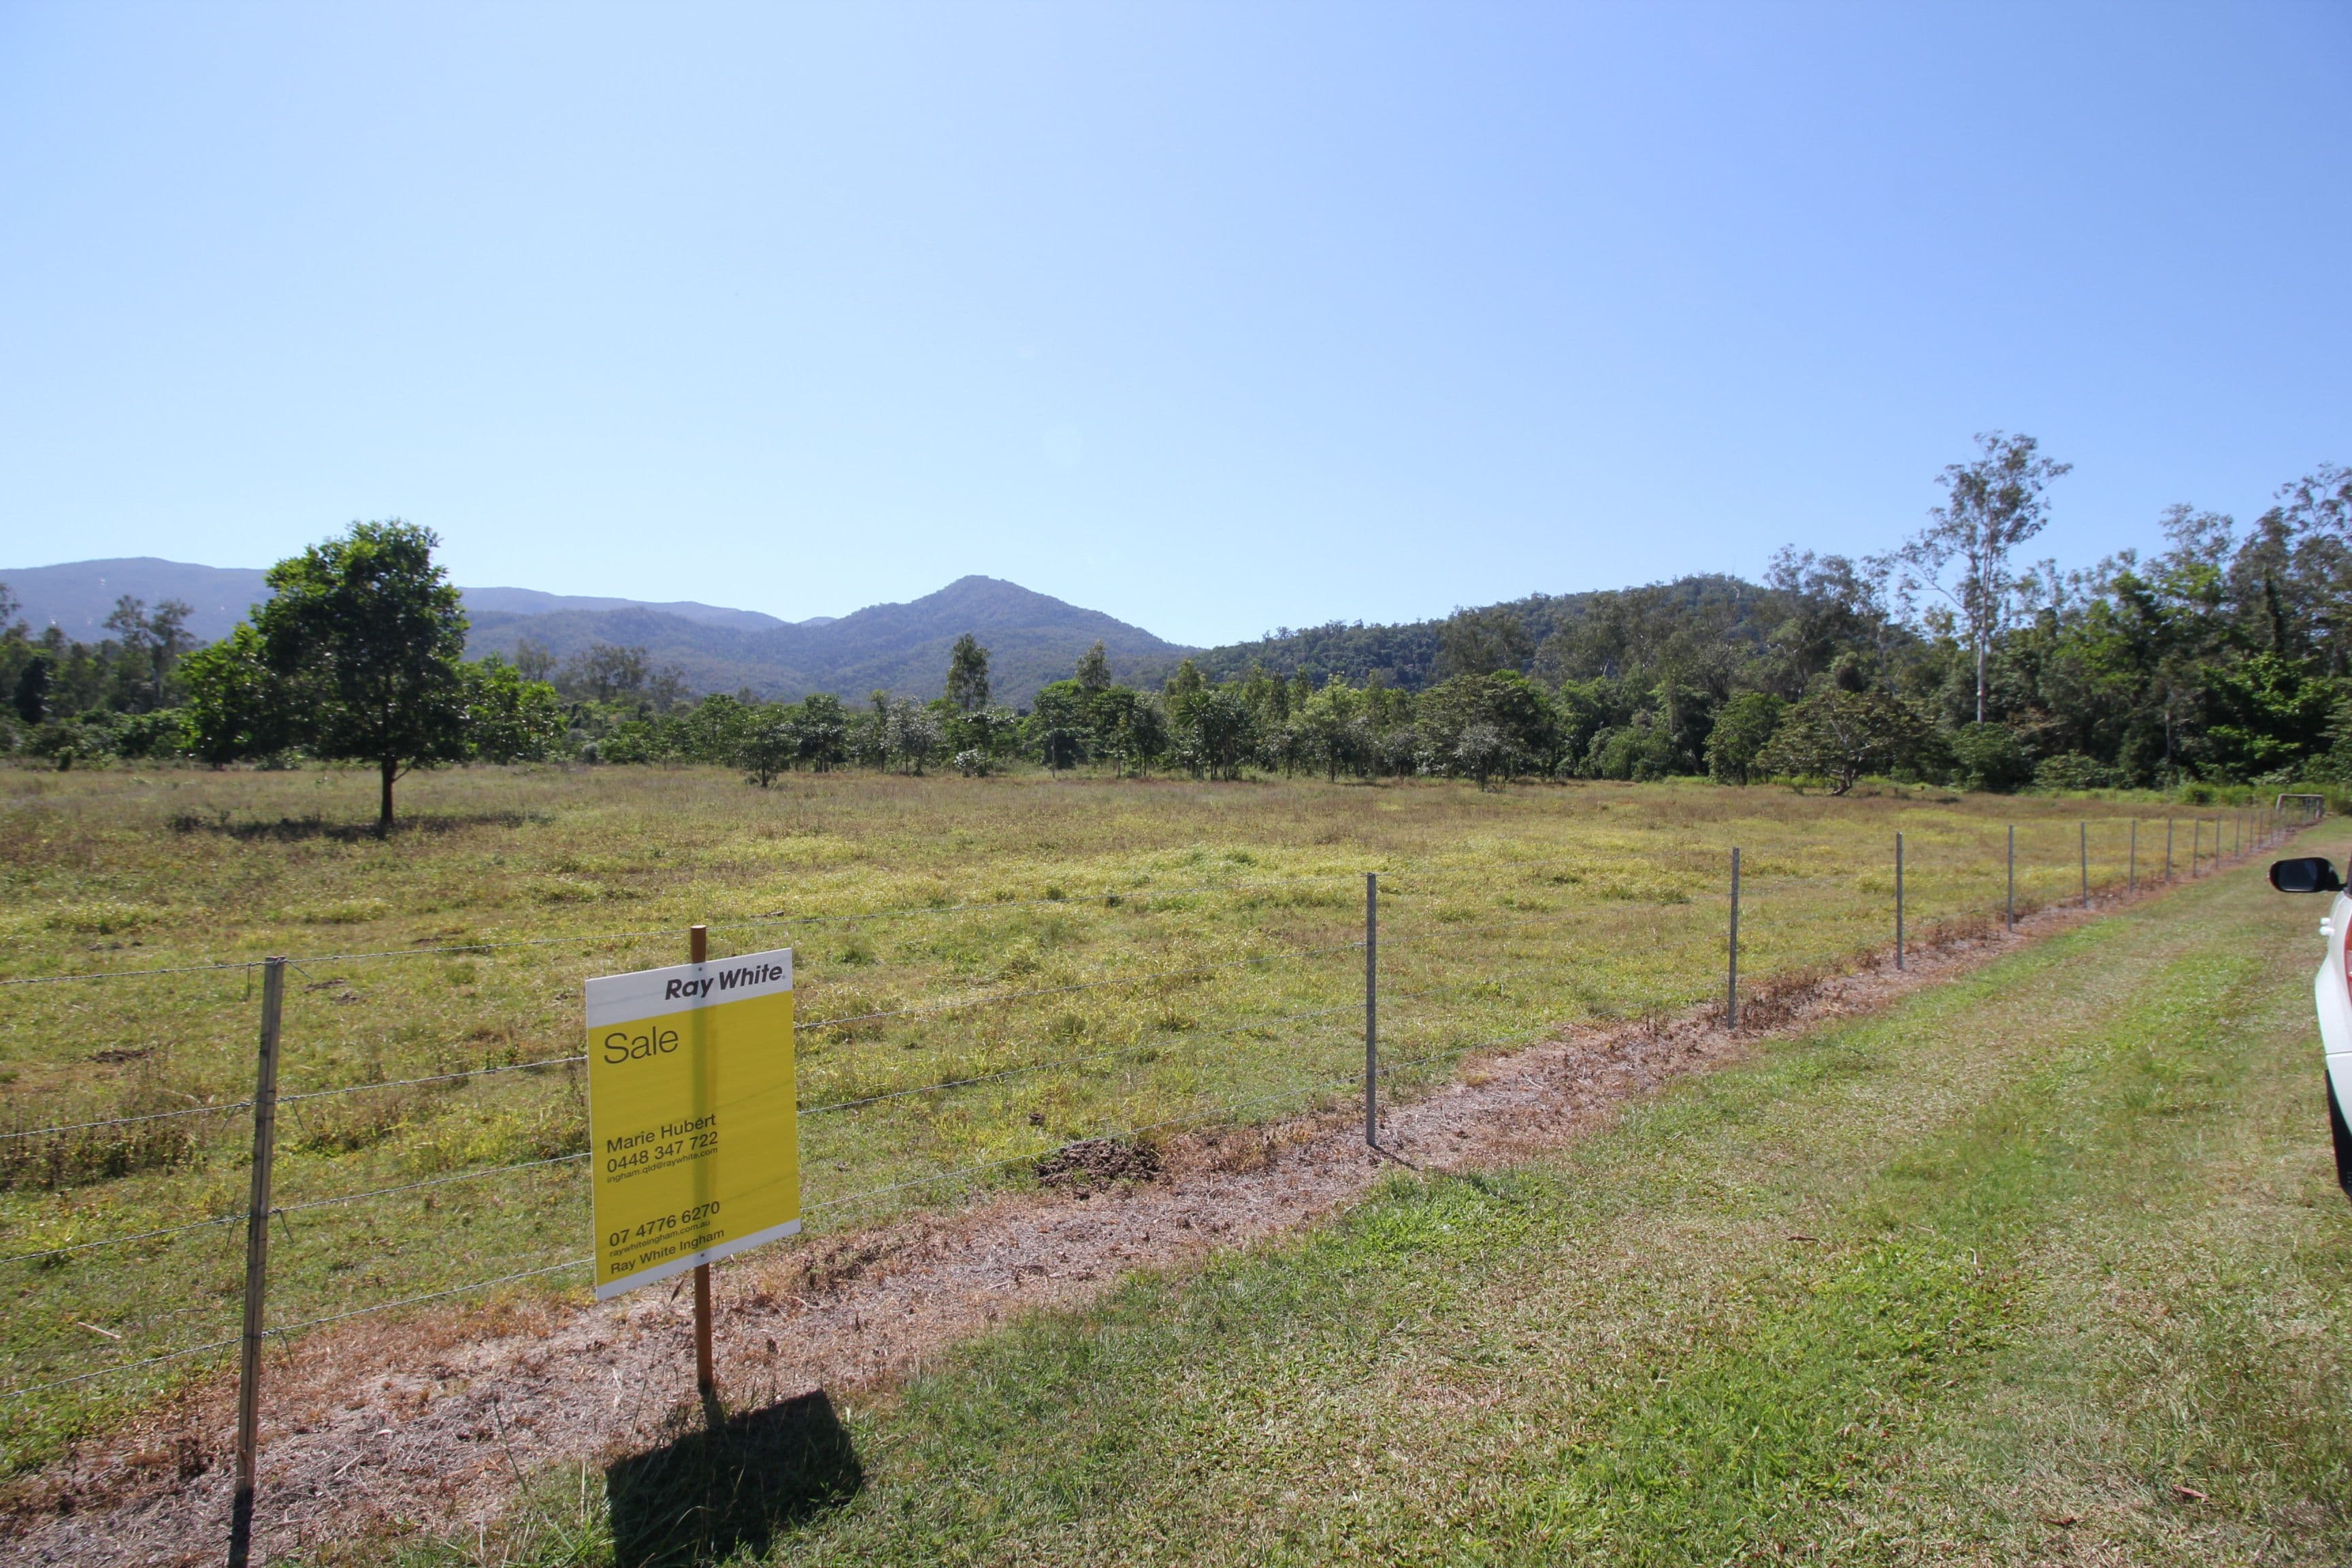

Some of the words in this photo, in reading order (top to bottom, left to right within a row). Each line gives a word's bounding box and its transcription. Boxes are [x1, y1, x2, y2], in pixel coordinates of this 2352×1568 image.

[665, 977, 715, 1000] Ray
[719, 964, 783, 990] White
[604, 1026, 679, 1064] Sale
[607, 1131, 655, 1154] Marie
[661, 1114, 716, 1139] Hubert
[607, 1150, 649, 1173] 0448
[655, 1141, 683, 1160] 347
[689, 1131, 718, 1150] 722
[607, 1147, 718, 1183] ingham.qld@raywhite.com
[609, 1229, 631, 1247] 07
[636, 1215, 676, 1237] 4776
[682, 1201, 720, 1224] 6270
[610, 1220, 710, 1257] raywhiteingham.com.au
[611, 1260, 636, 1274] Ray
[640, 1246, 676, 1264] White
[680, 1230, 724, 1251] Ingham
